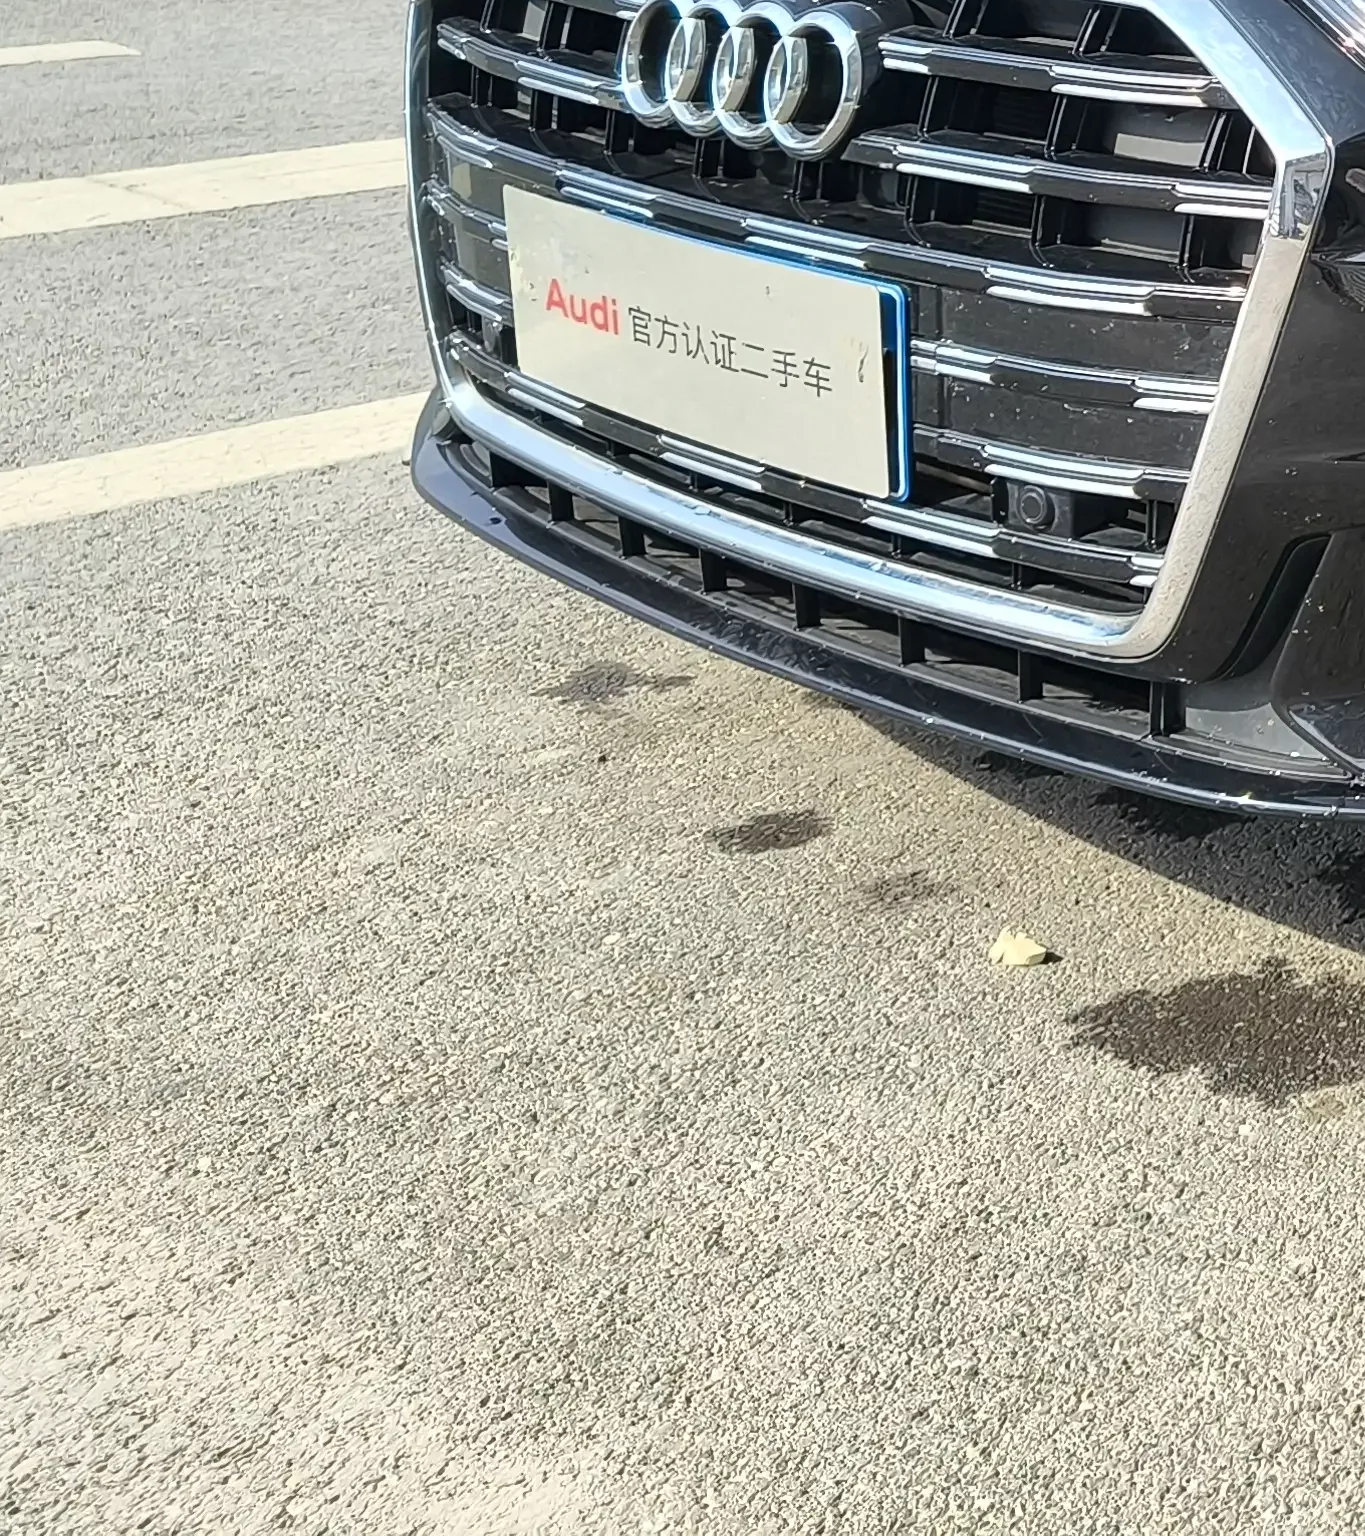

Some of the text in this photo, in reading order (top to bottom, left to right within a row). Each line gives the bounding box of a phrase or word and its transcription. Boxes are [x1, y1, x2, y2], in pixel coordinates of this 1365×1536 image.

[546, 278, 832, 398] Audi 官方认证二手车
